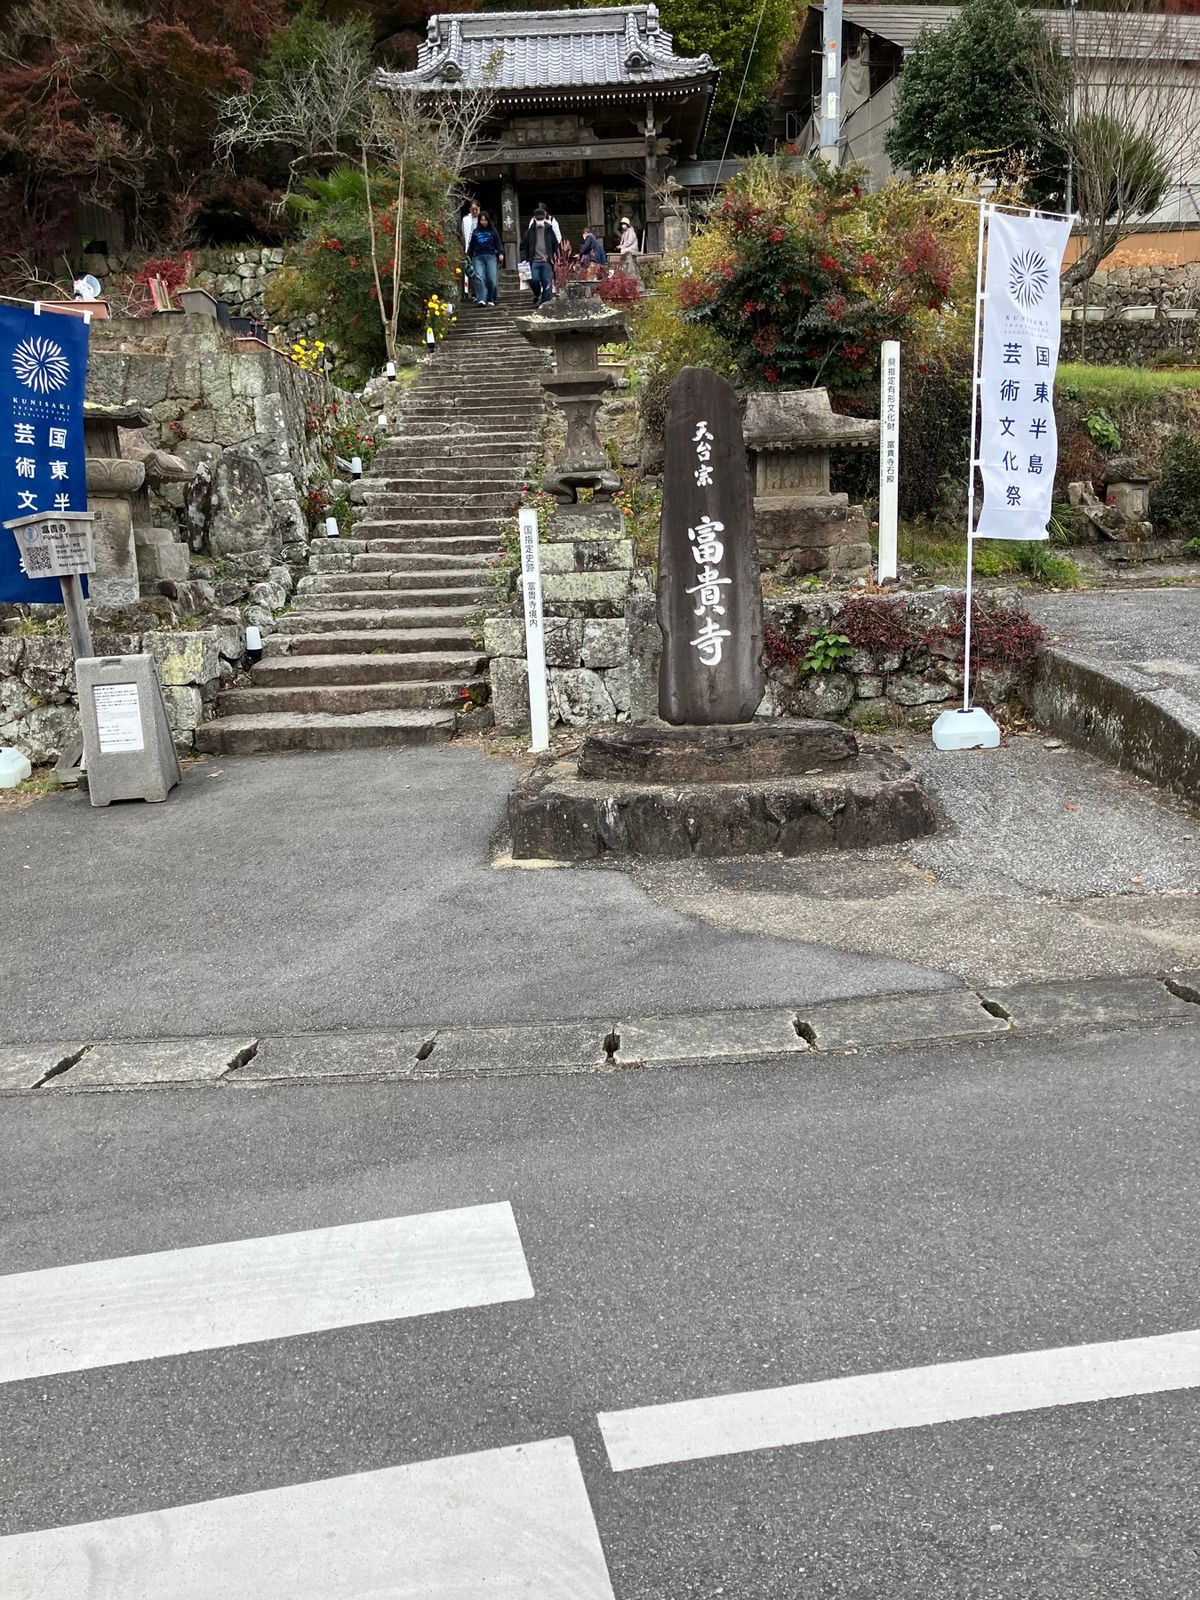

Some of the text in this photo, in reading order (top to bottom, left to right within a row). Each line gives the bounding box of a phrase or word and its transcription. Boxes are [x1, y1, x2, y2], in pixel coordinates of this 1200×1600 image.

[13, 397, 70, 411] KUNISAKI
[887, 357, 896, 431] 県指定有形文化財
[1000, 342, 1022, 507] 芸術文化祭
[1027, 345, 1050, 475] 国東半島
[14, 422, 38, 573] 芸術文
[49, 427, 70, 511] 国東半
[524, 525, 538, 628] 国指定史跡 富貴寺境内
[685, 420, 732, 666] 天台宗 富貴寺
